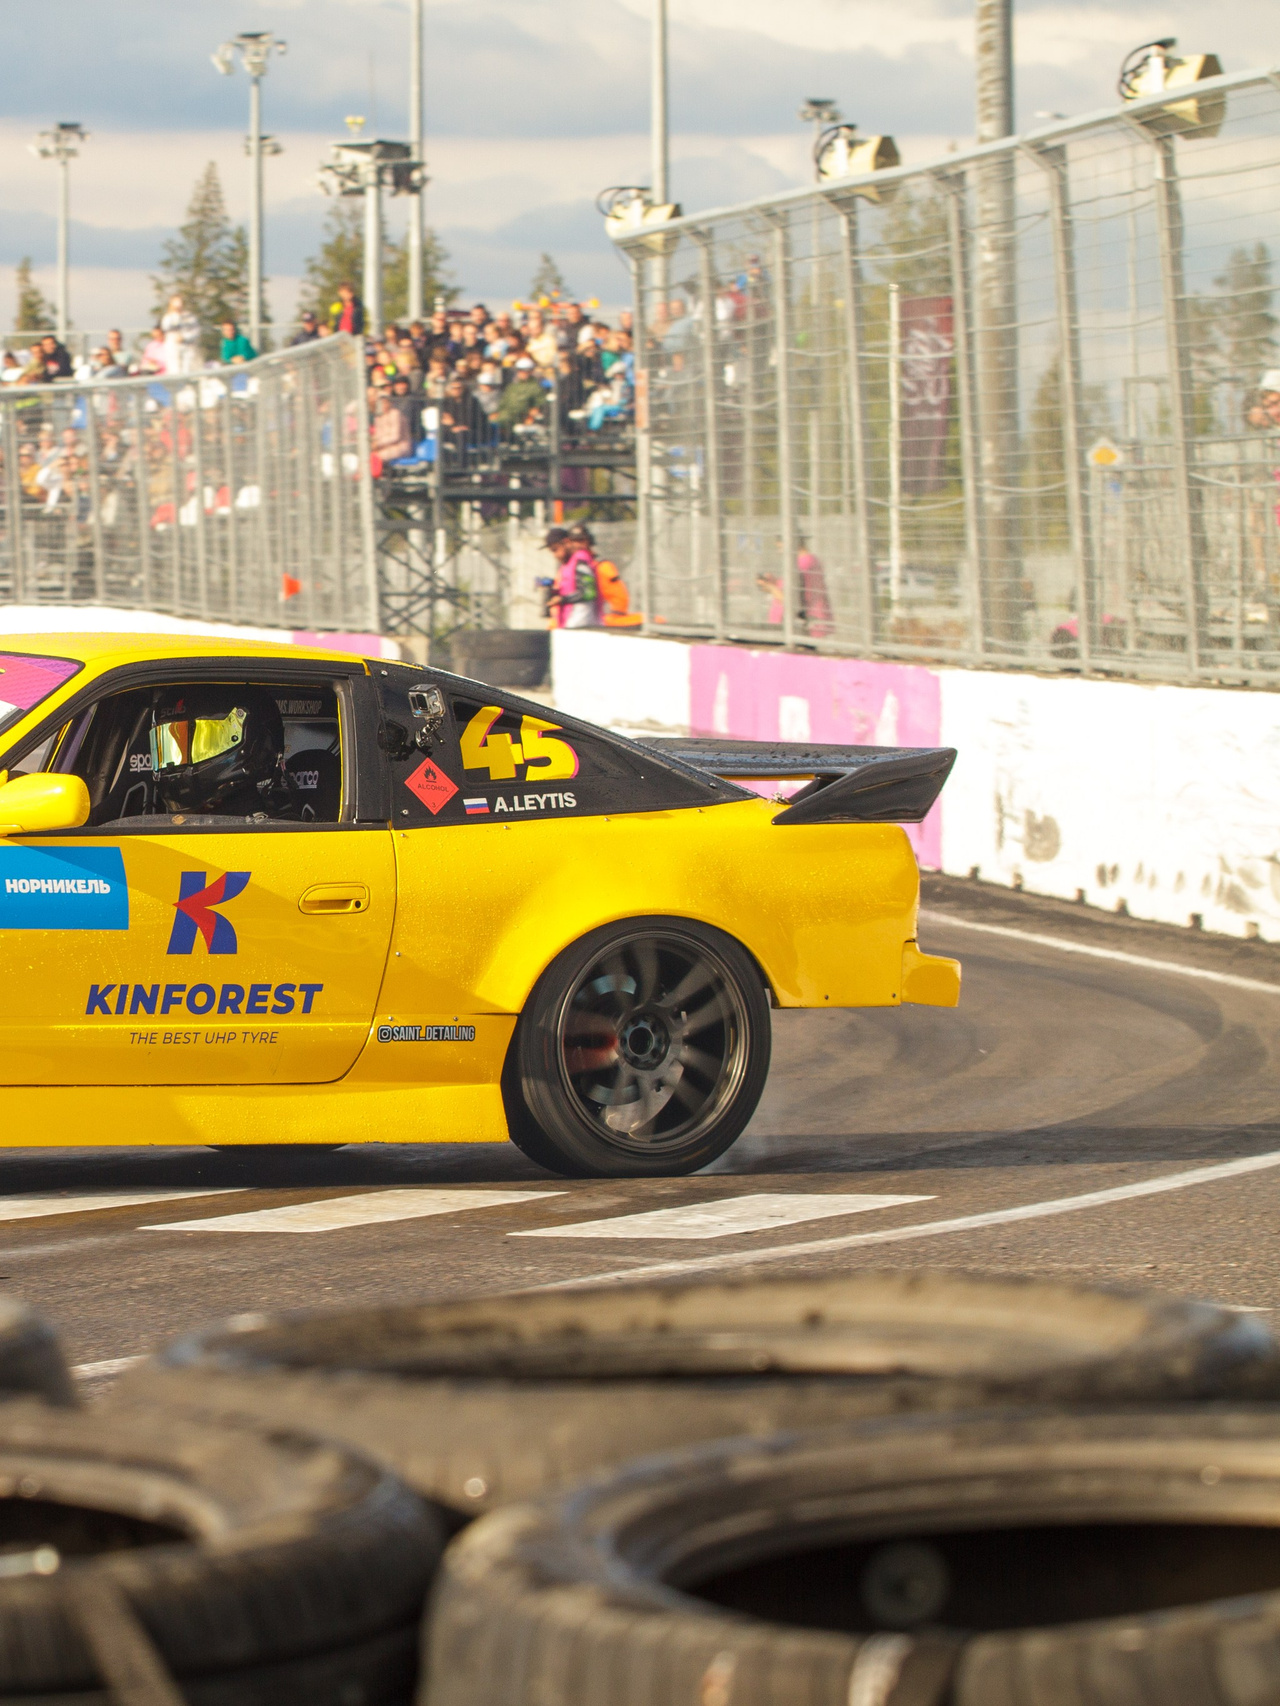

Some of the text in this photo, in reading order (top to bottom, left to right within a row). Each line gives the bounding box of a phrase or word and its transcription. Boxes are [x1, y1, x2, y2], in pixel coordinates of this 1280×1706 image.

[460, 706, 580, 782] 45
[416, 782, 450, 794] ALCOHOL
[431, 801, 437, 809] 3
[494, 792, 578, 813] A.LEYTIS
[5, 877, 111, 895] НОРНИКЕЛЬ
[85, 983, 324, 1016] KINFOREST
[129, 1031, 280, 1045] THE BEST UHP TYRE
